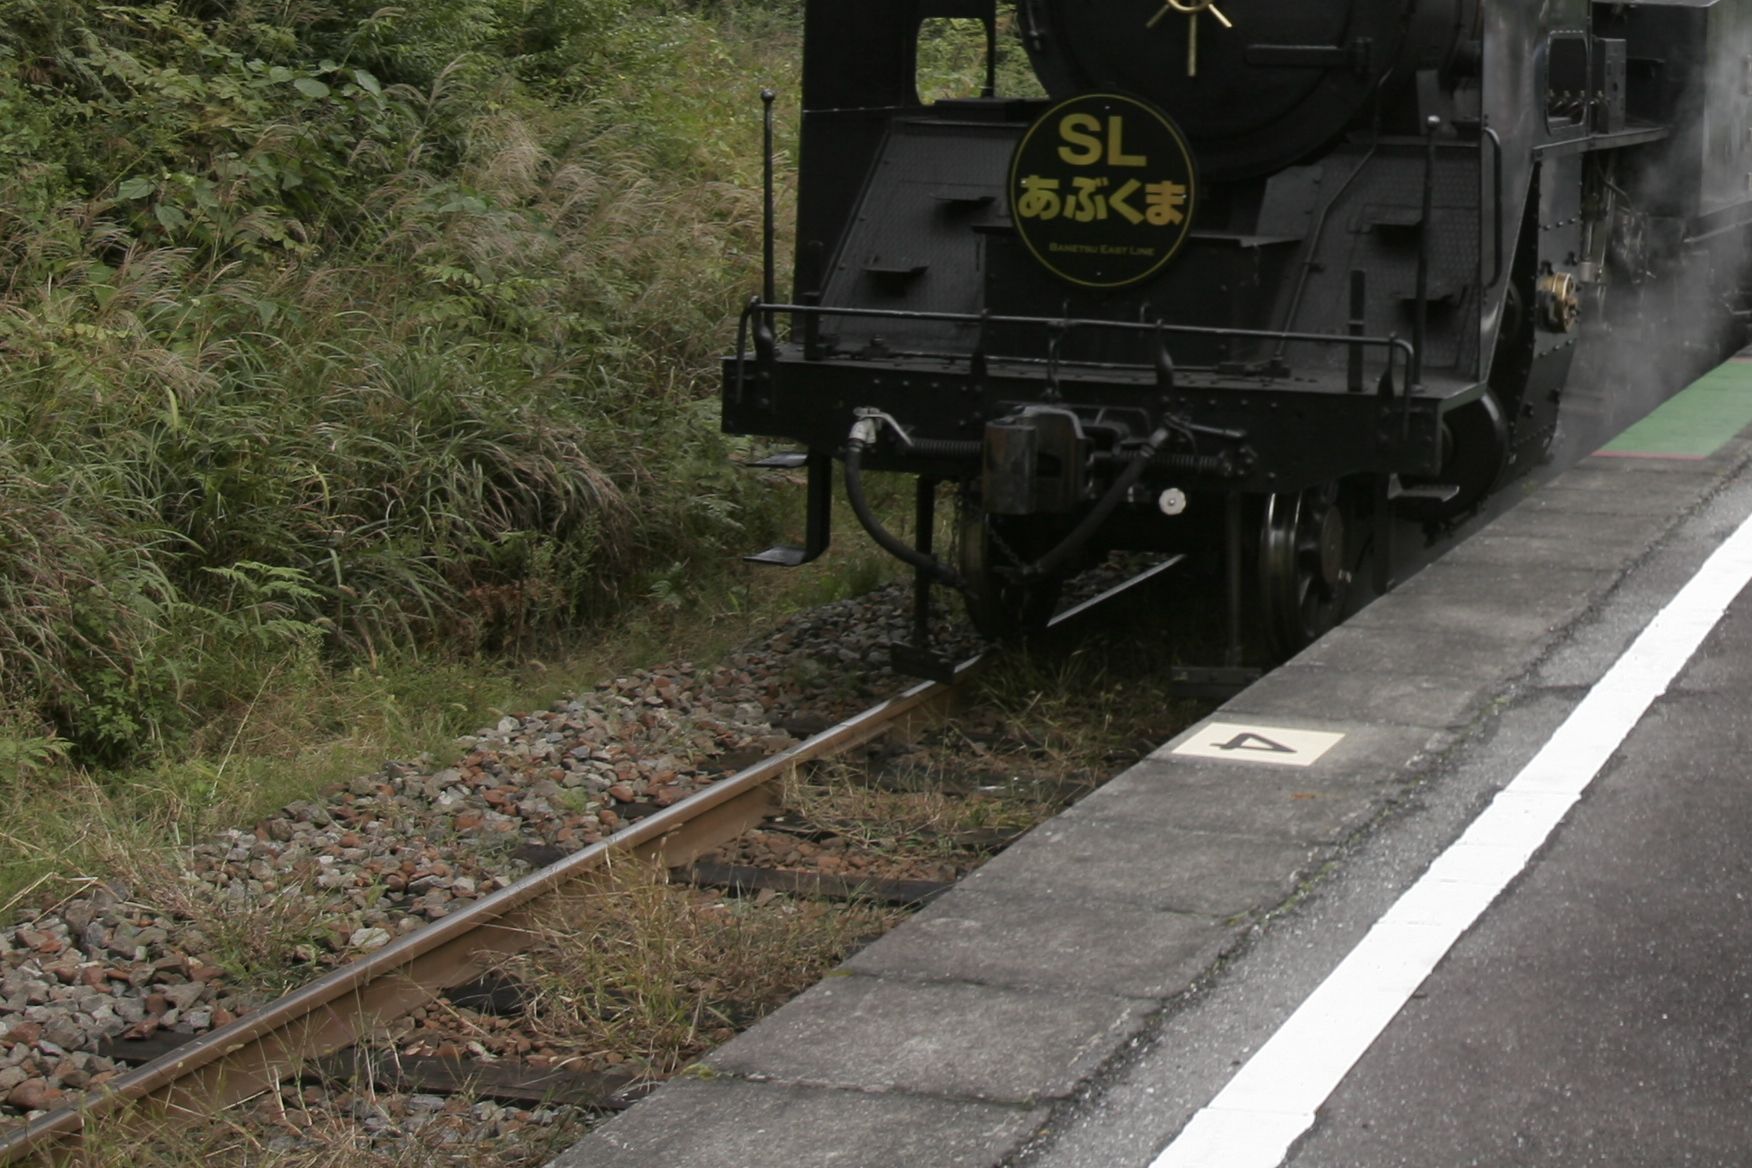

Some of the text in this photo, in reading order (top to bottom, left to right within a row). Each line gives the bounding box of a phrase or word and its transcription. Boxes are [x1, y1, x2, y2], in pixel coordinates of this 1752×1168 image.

[1057, 112, 1147, 167] SL
[1018, 174, 1187, 226] あぶくま
[1209, 732, 1298, 754] 4
